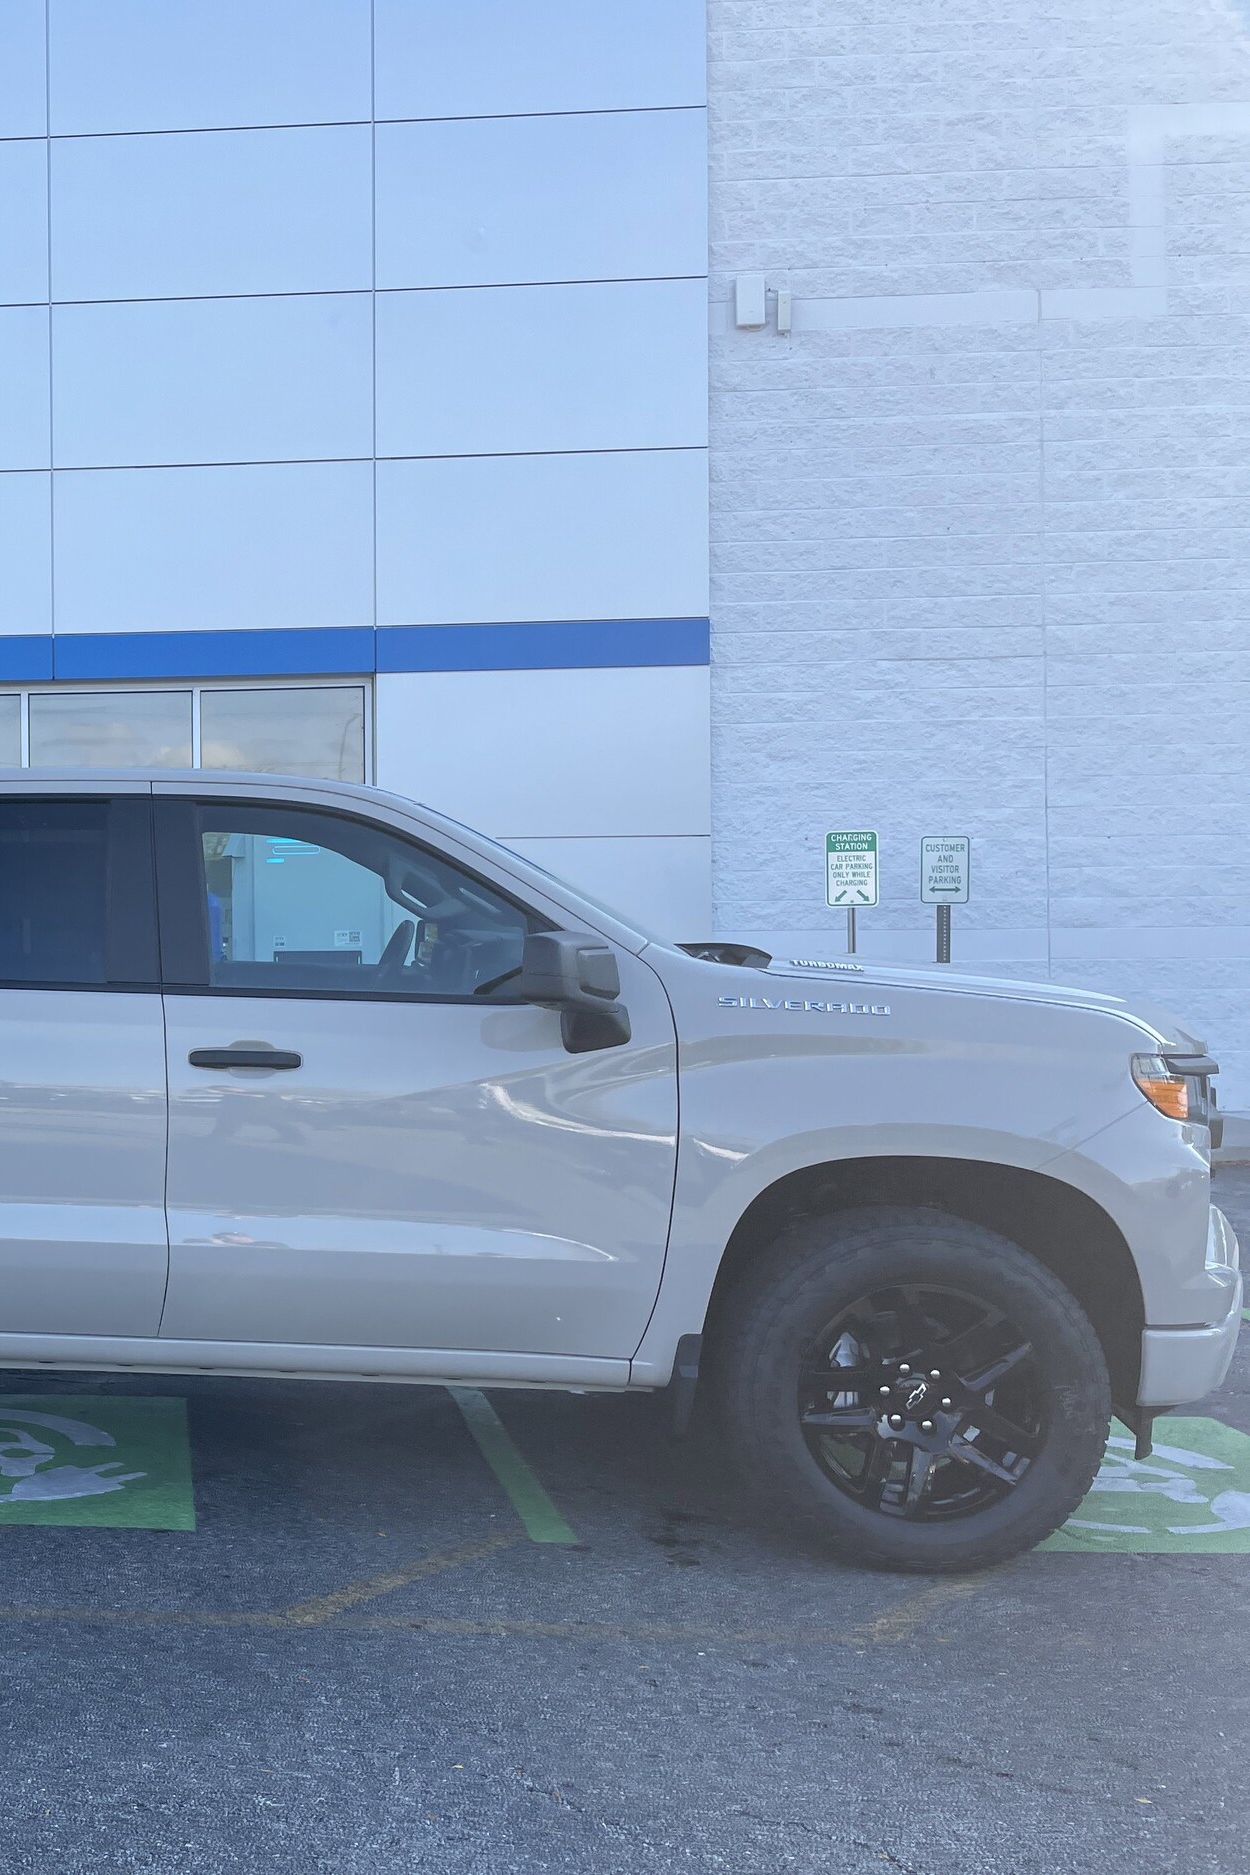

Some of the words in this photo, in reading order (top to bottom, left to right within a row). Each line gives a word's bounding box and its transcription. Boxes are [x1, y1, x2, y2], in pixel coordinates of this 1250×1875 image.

[830, 833, 872, 842] CHARGING
[835, 842, 868, 850] STATION
[925, 843, 965, 852] CUSTOMER
[937, 854, 953, 863] AND
[931, 865, 960, 873] VISITOR
[928, 876, 962, 884] PARKING
[718, 996, 891, 1016] SILVERADO
